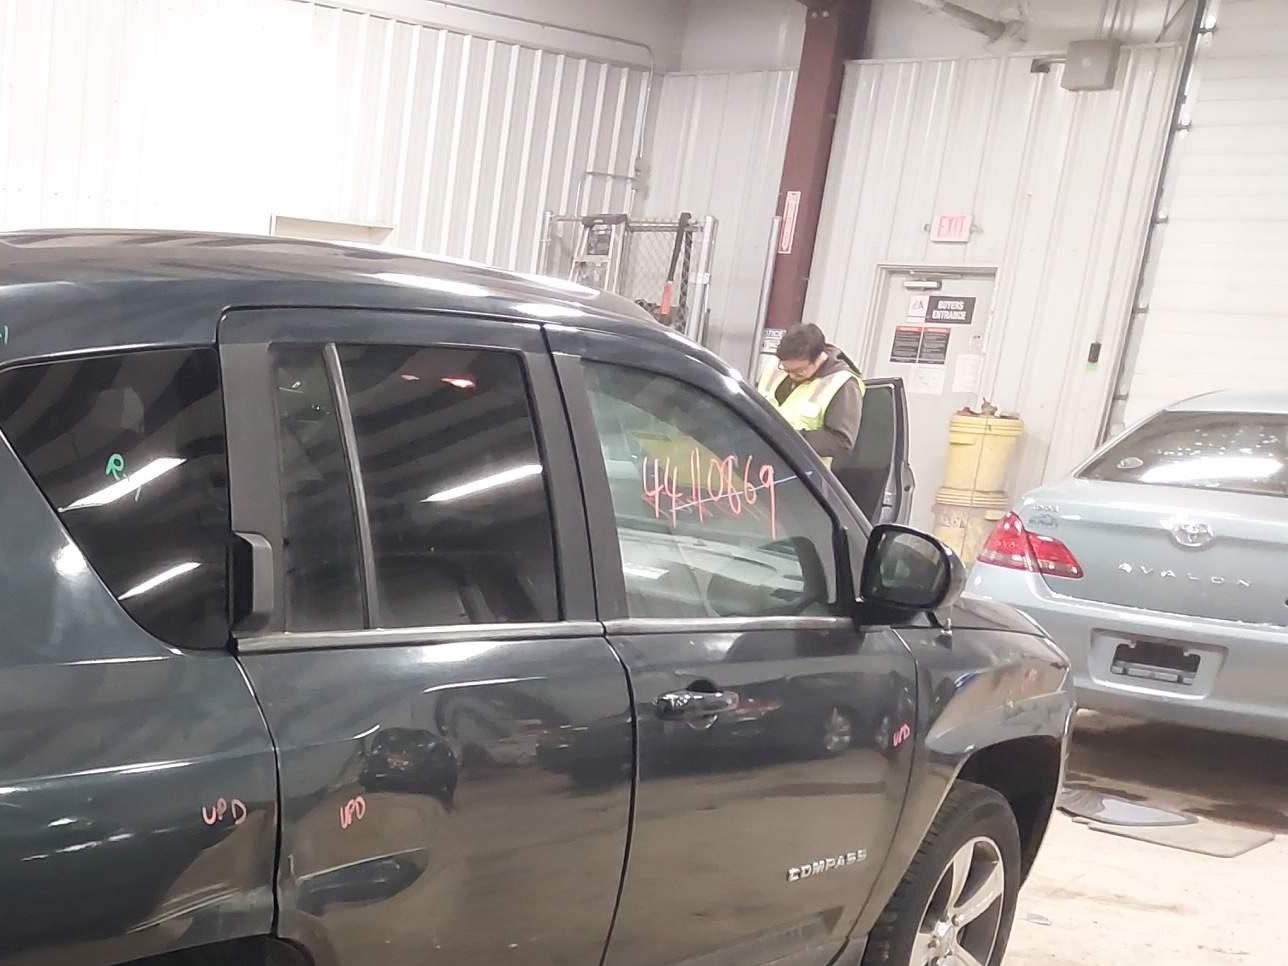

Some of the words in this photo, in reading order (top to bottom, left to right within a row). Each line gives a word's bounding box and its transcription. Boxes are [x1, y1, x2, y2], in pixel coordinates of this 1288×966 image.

[937, 215, 967, 239] EXIT
[931, 310, 967, 320] ENTRANCE
[1117, 562, 1251, 588] AVALON
[202, 797, 247, 825] UPD
[787, 848, 867, 882] COMPASS
